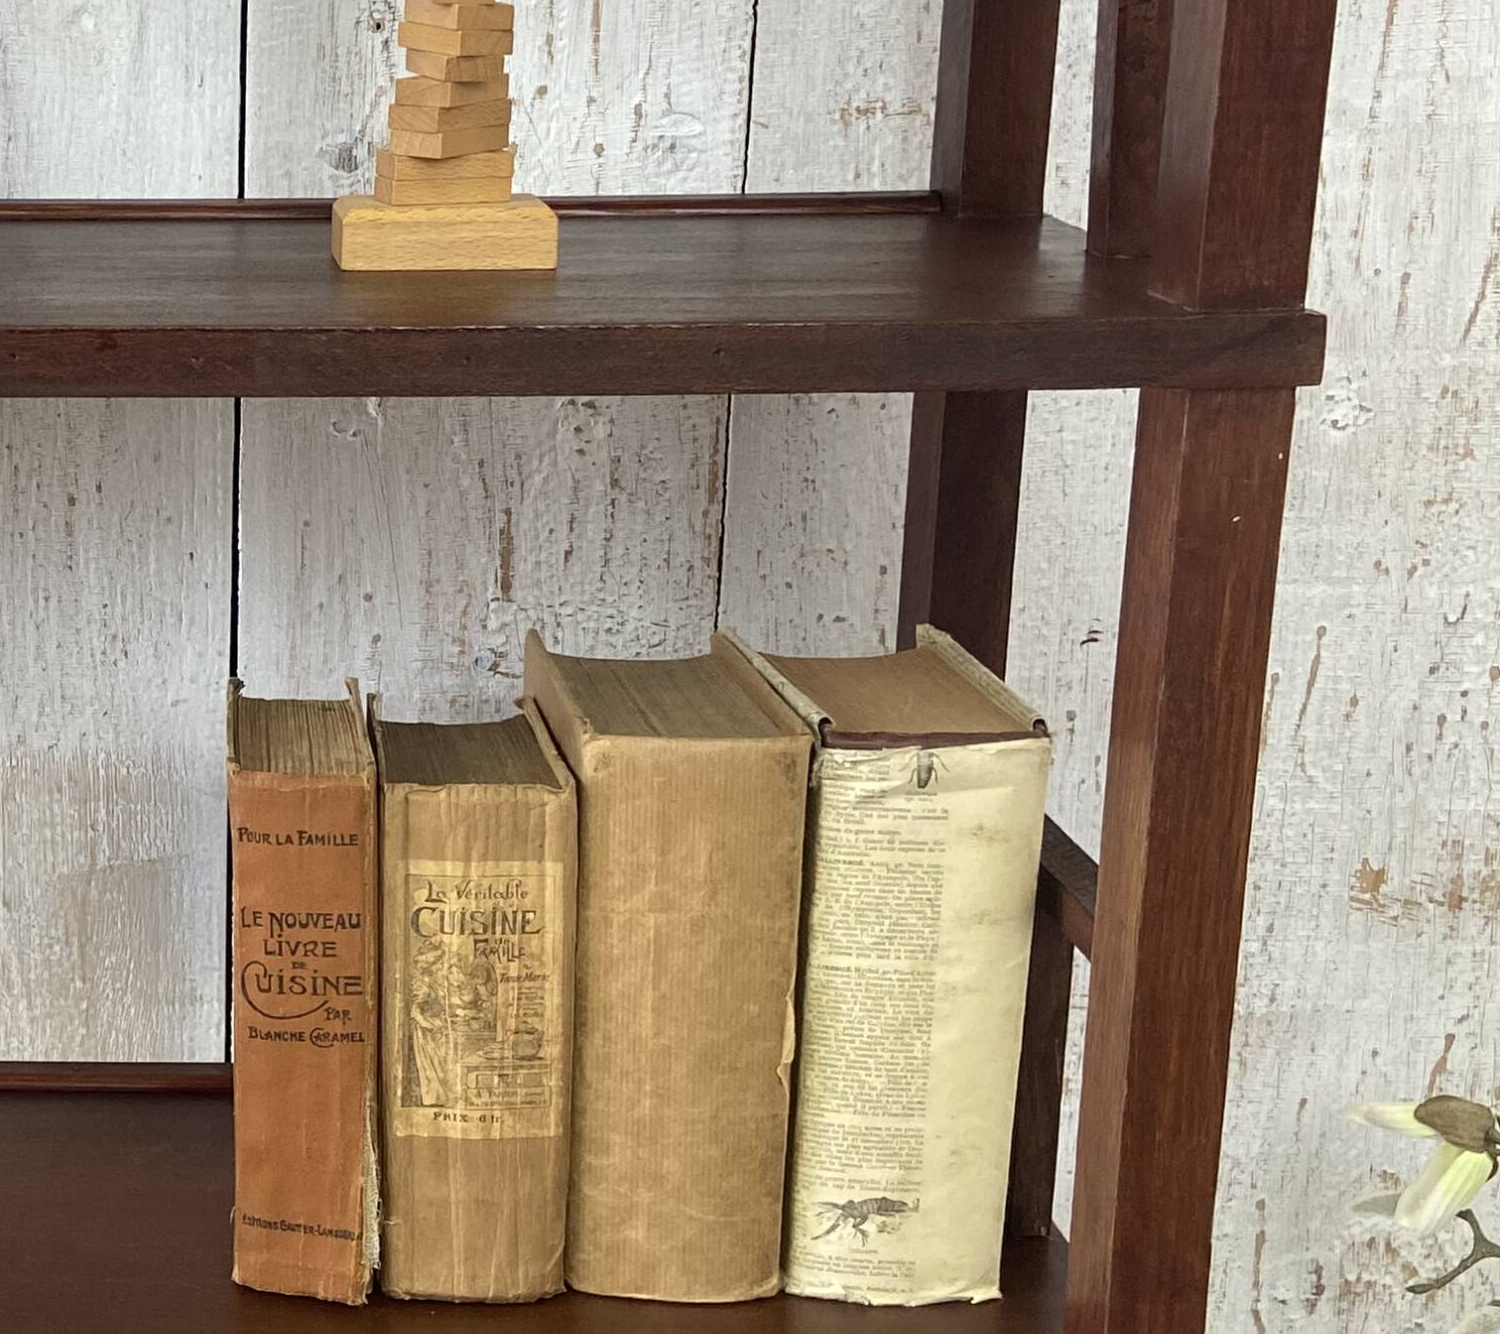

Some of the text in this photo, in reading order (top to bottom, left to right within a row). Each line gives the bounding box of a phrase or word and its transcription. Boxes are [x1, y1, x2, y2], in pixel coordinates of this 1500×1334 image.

[237, 827, 358, 846] POUR LA FAMILLE
[424, 879, 447, 904] La
[240, 906, 362, 938] LE NOUVEAU
[411, 907, 546, 938] CUISINE
[263, 933, 337, 957] LIVRE
[241, 960, 364, 1020] CUISINE
[248, 1026, 365, 1048] BLANCHE CARAMEL
[433, 1111, 469, 1123] PRIX
